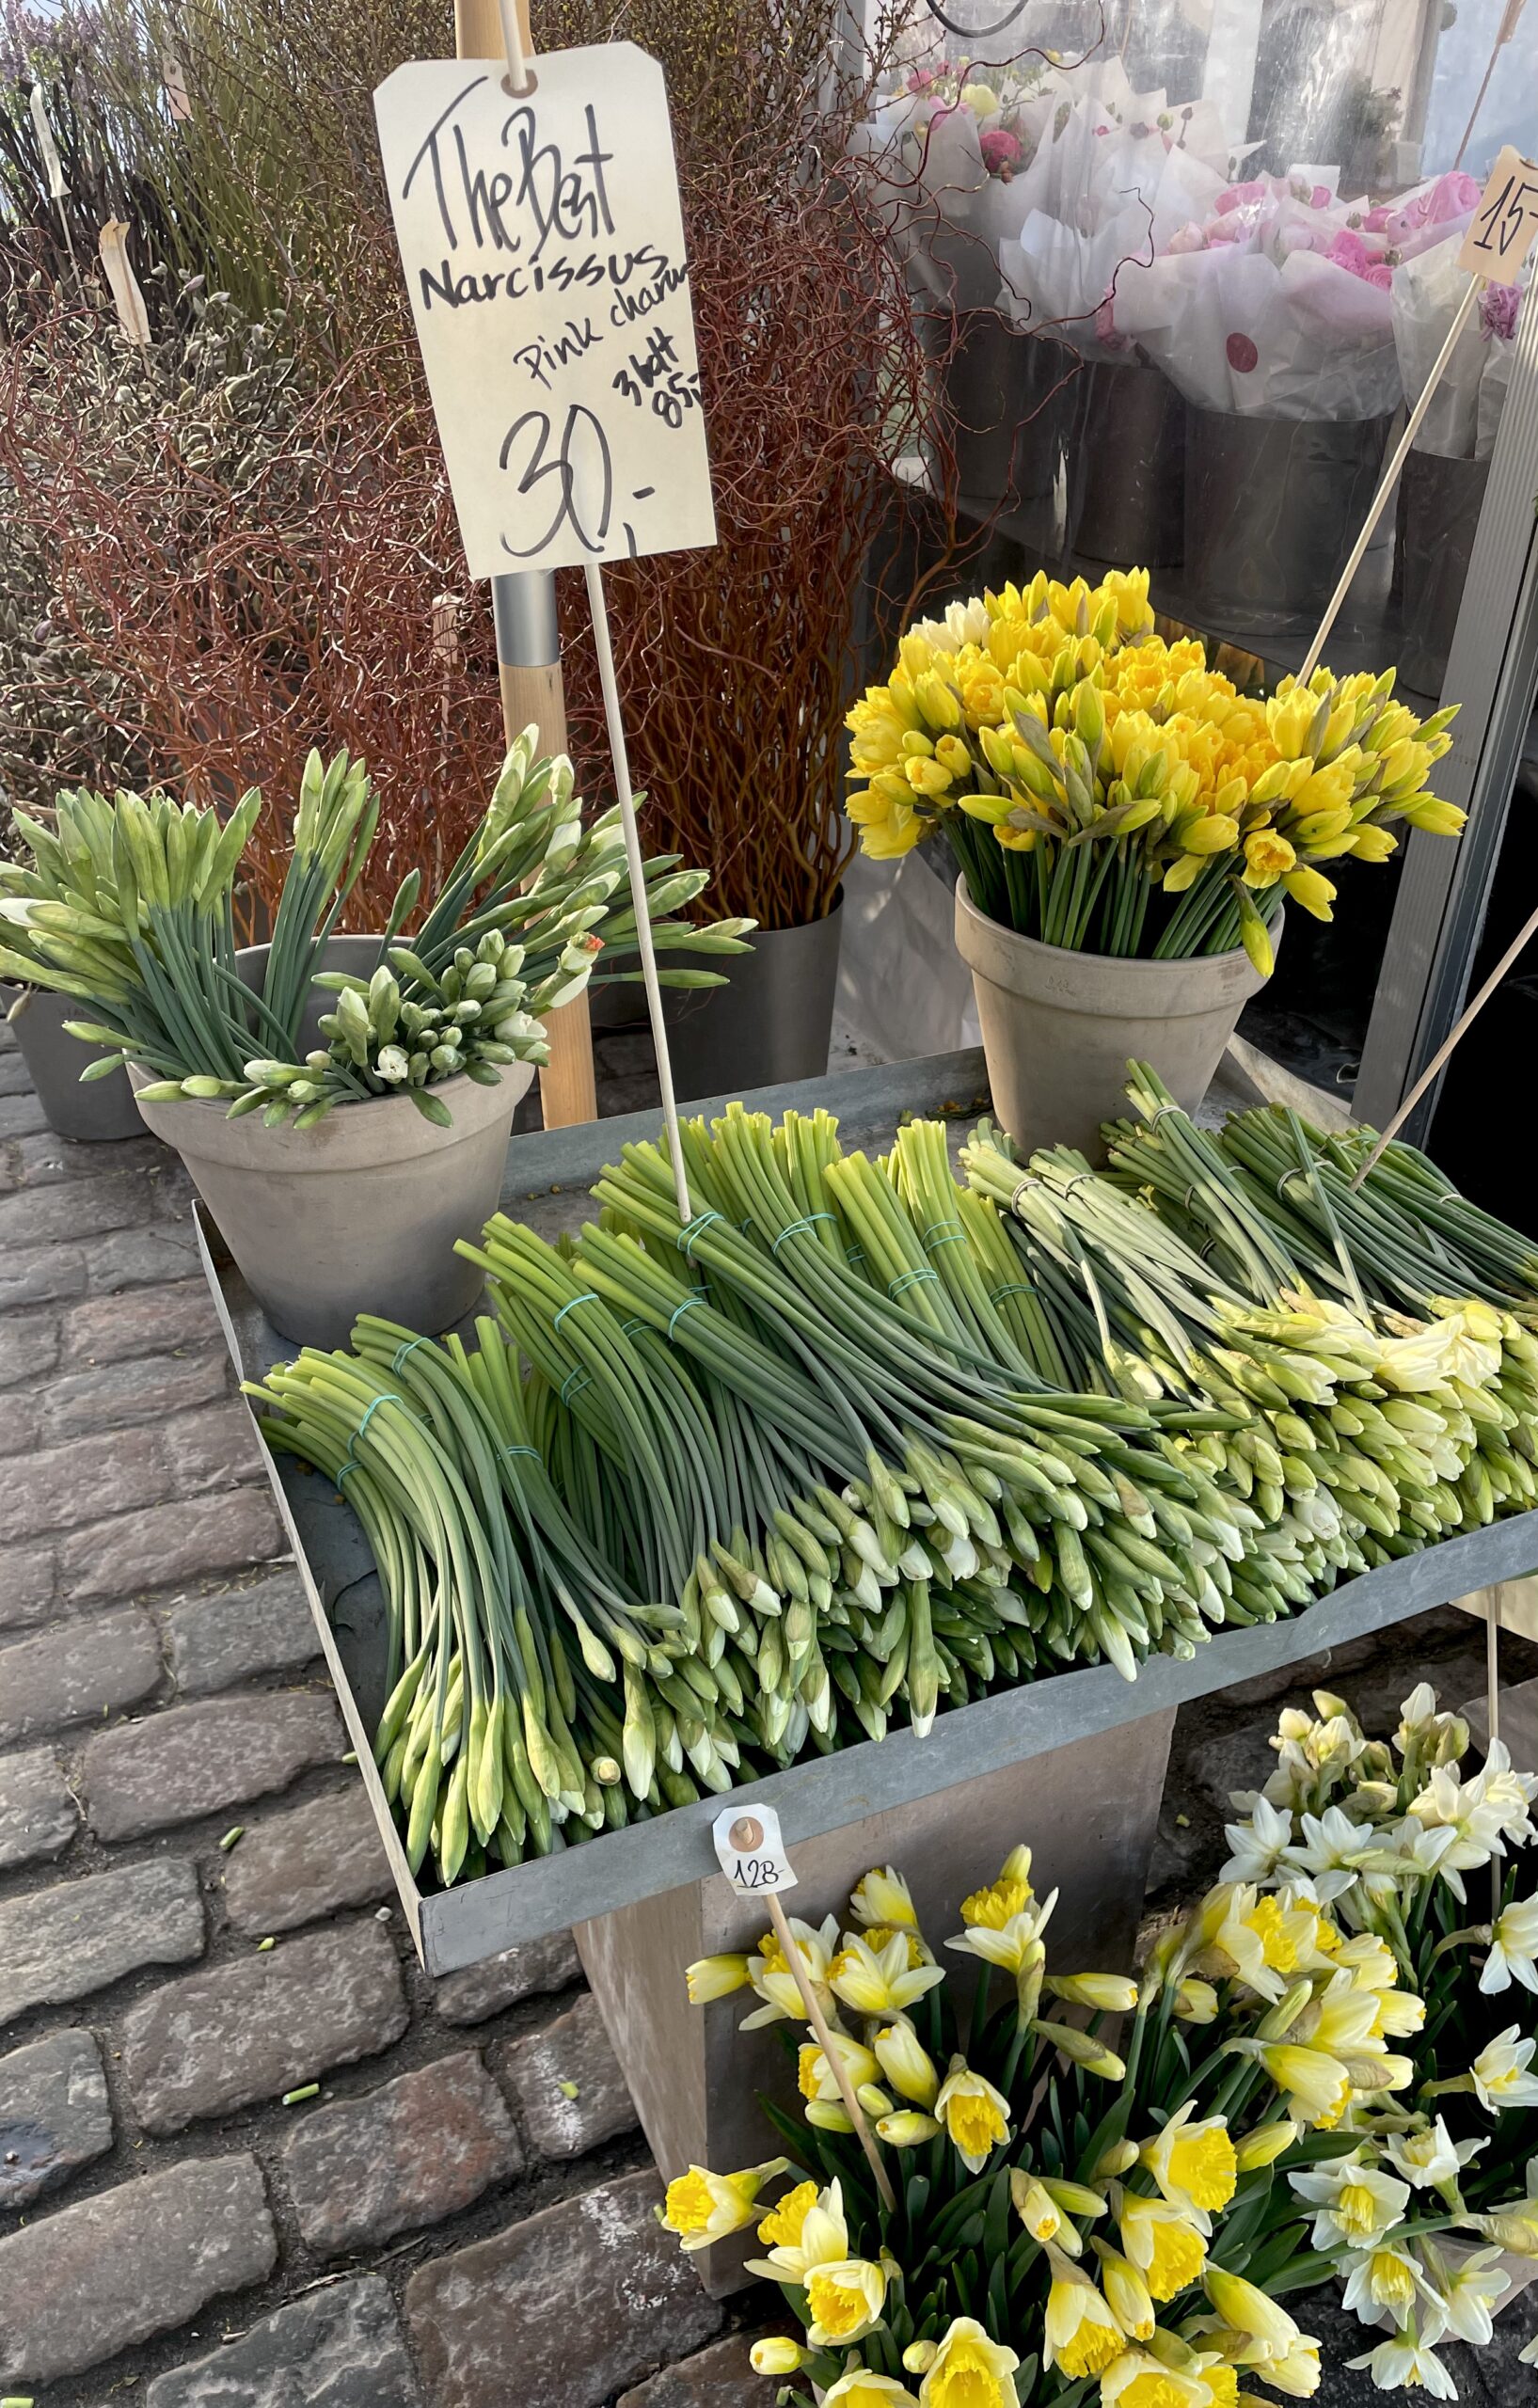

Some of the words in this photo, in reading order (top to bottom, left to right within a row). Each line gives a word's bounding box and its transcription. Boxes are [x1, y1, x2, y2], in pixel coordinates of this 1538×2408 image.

[402, 75, 521, 252] The
[500, 103, 616, 265] Best
[419, 246, 669, 309] Narcissus
[513, 317, 604, 390] Pink
[611, 370, 642, 406] 3
